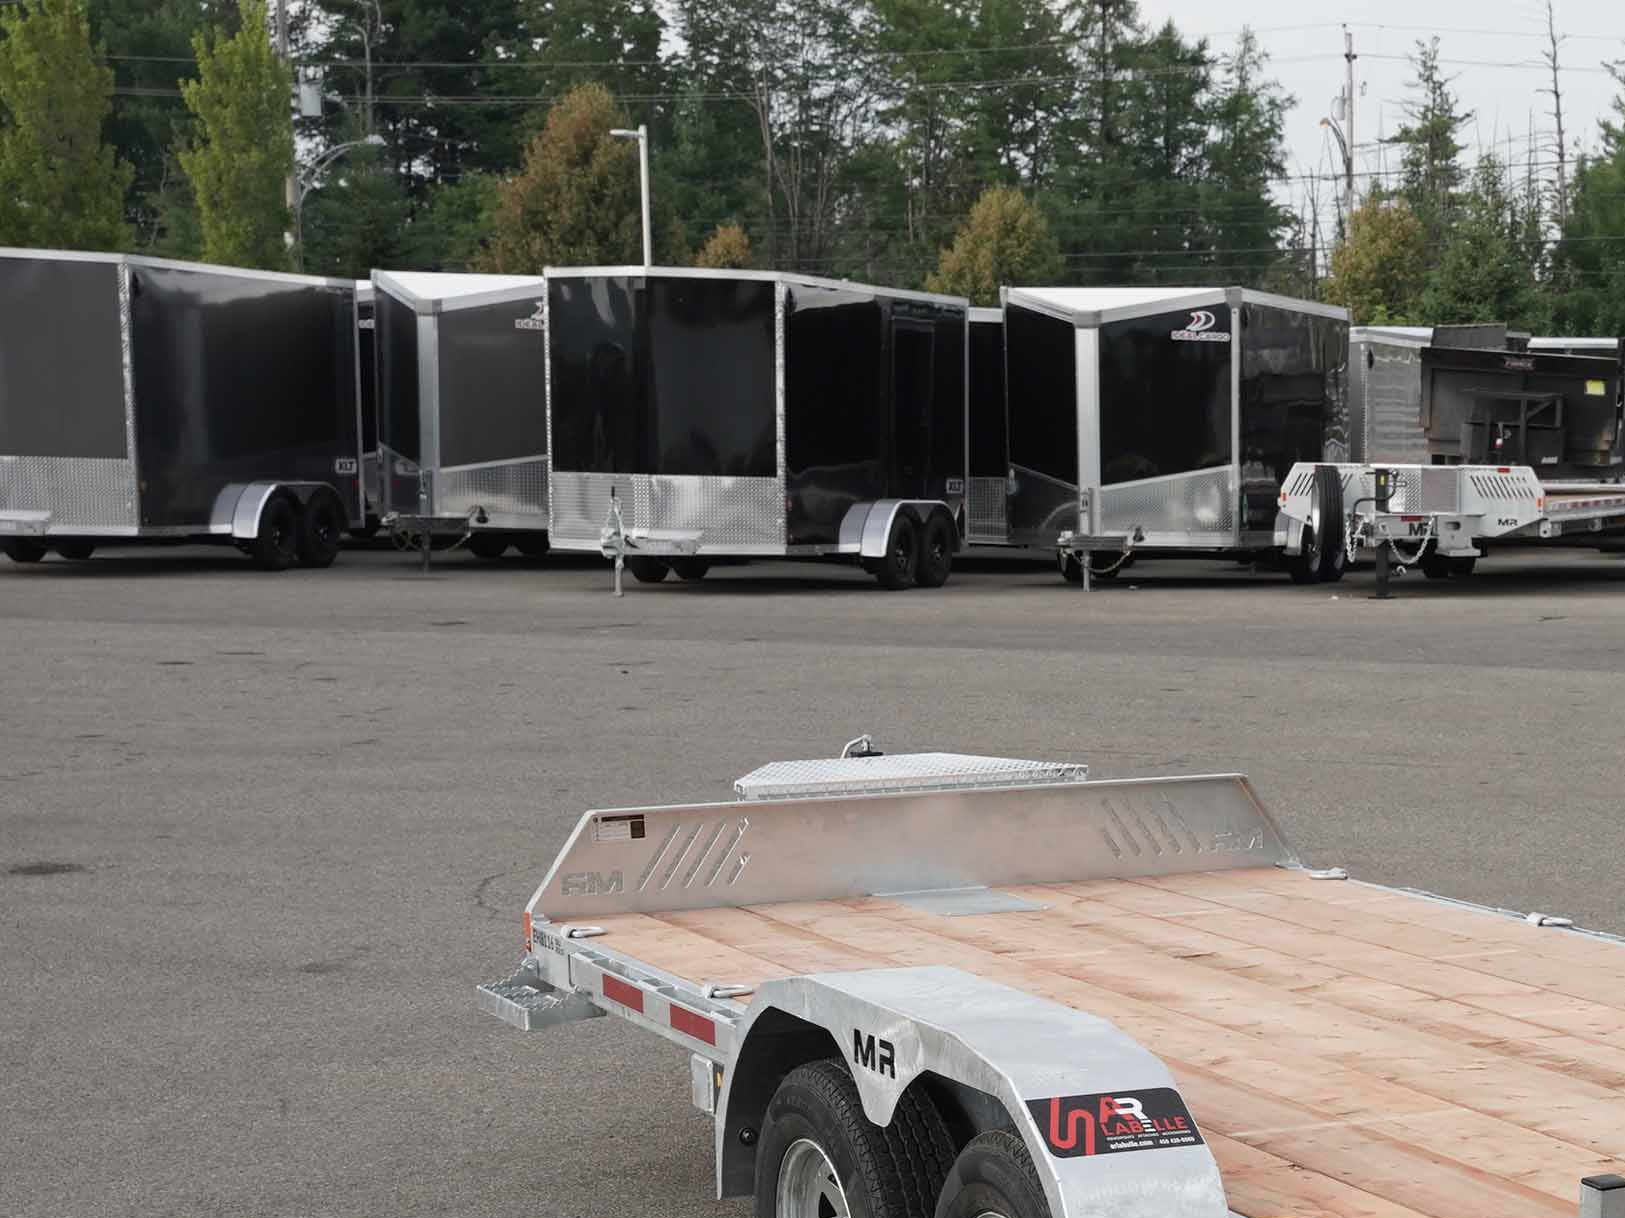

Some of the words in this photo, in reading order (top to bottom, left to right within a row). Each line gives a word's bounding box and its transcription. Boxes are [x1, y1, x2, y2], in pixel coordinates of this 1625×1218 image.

[1497, 518, 1518, 526] MR
[854, 1028, 895, 1079] MR
[1100, 1116, 1189, 1137] LABELLE
